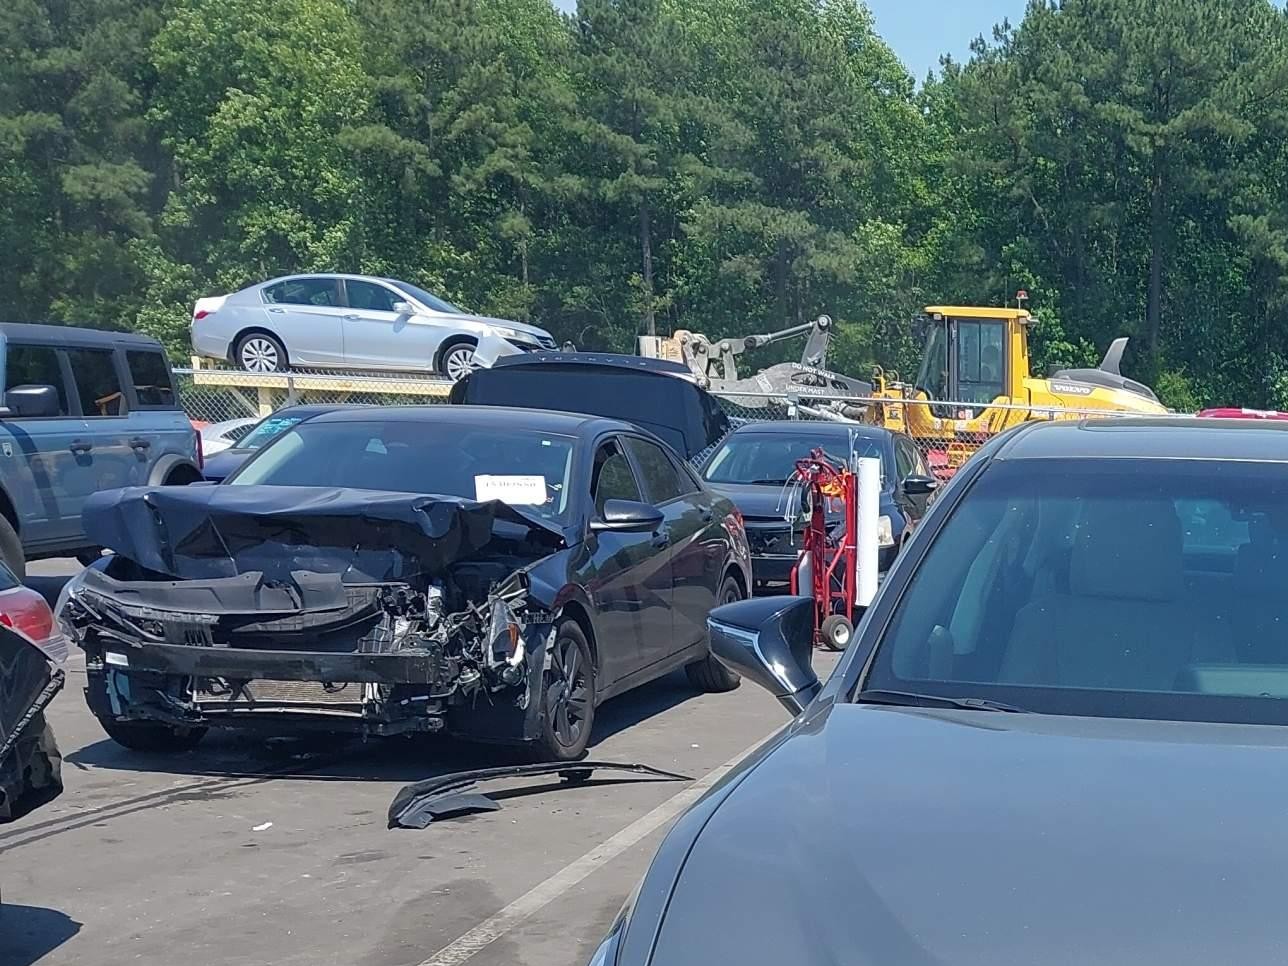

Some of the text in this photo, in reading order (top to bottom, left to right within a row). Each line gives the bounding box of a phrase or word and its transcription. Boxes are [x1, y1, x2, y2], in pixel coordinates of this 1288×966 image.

[791, 362, 836, 380] DO NOT WALK
[785, 384, 825, 395] UNDER MAST
[1053, 384, 1091, 394] VOLVO
